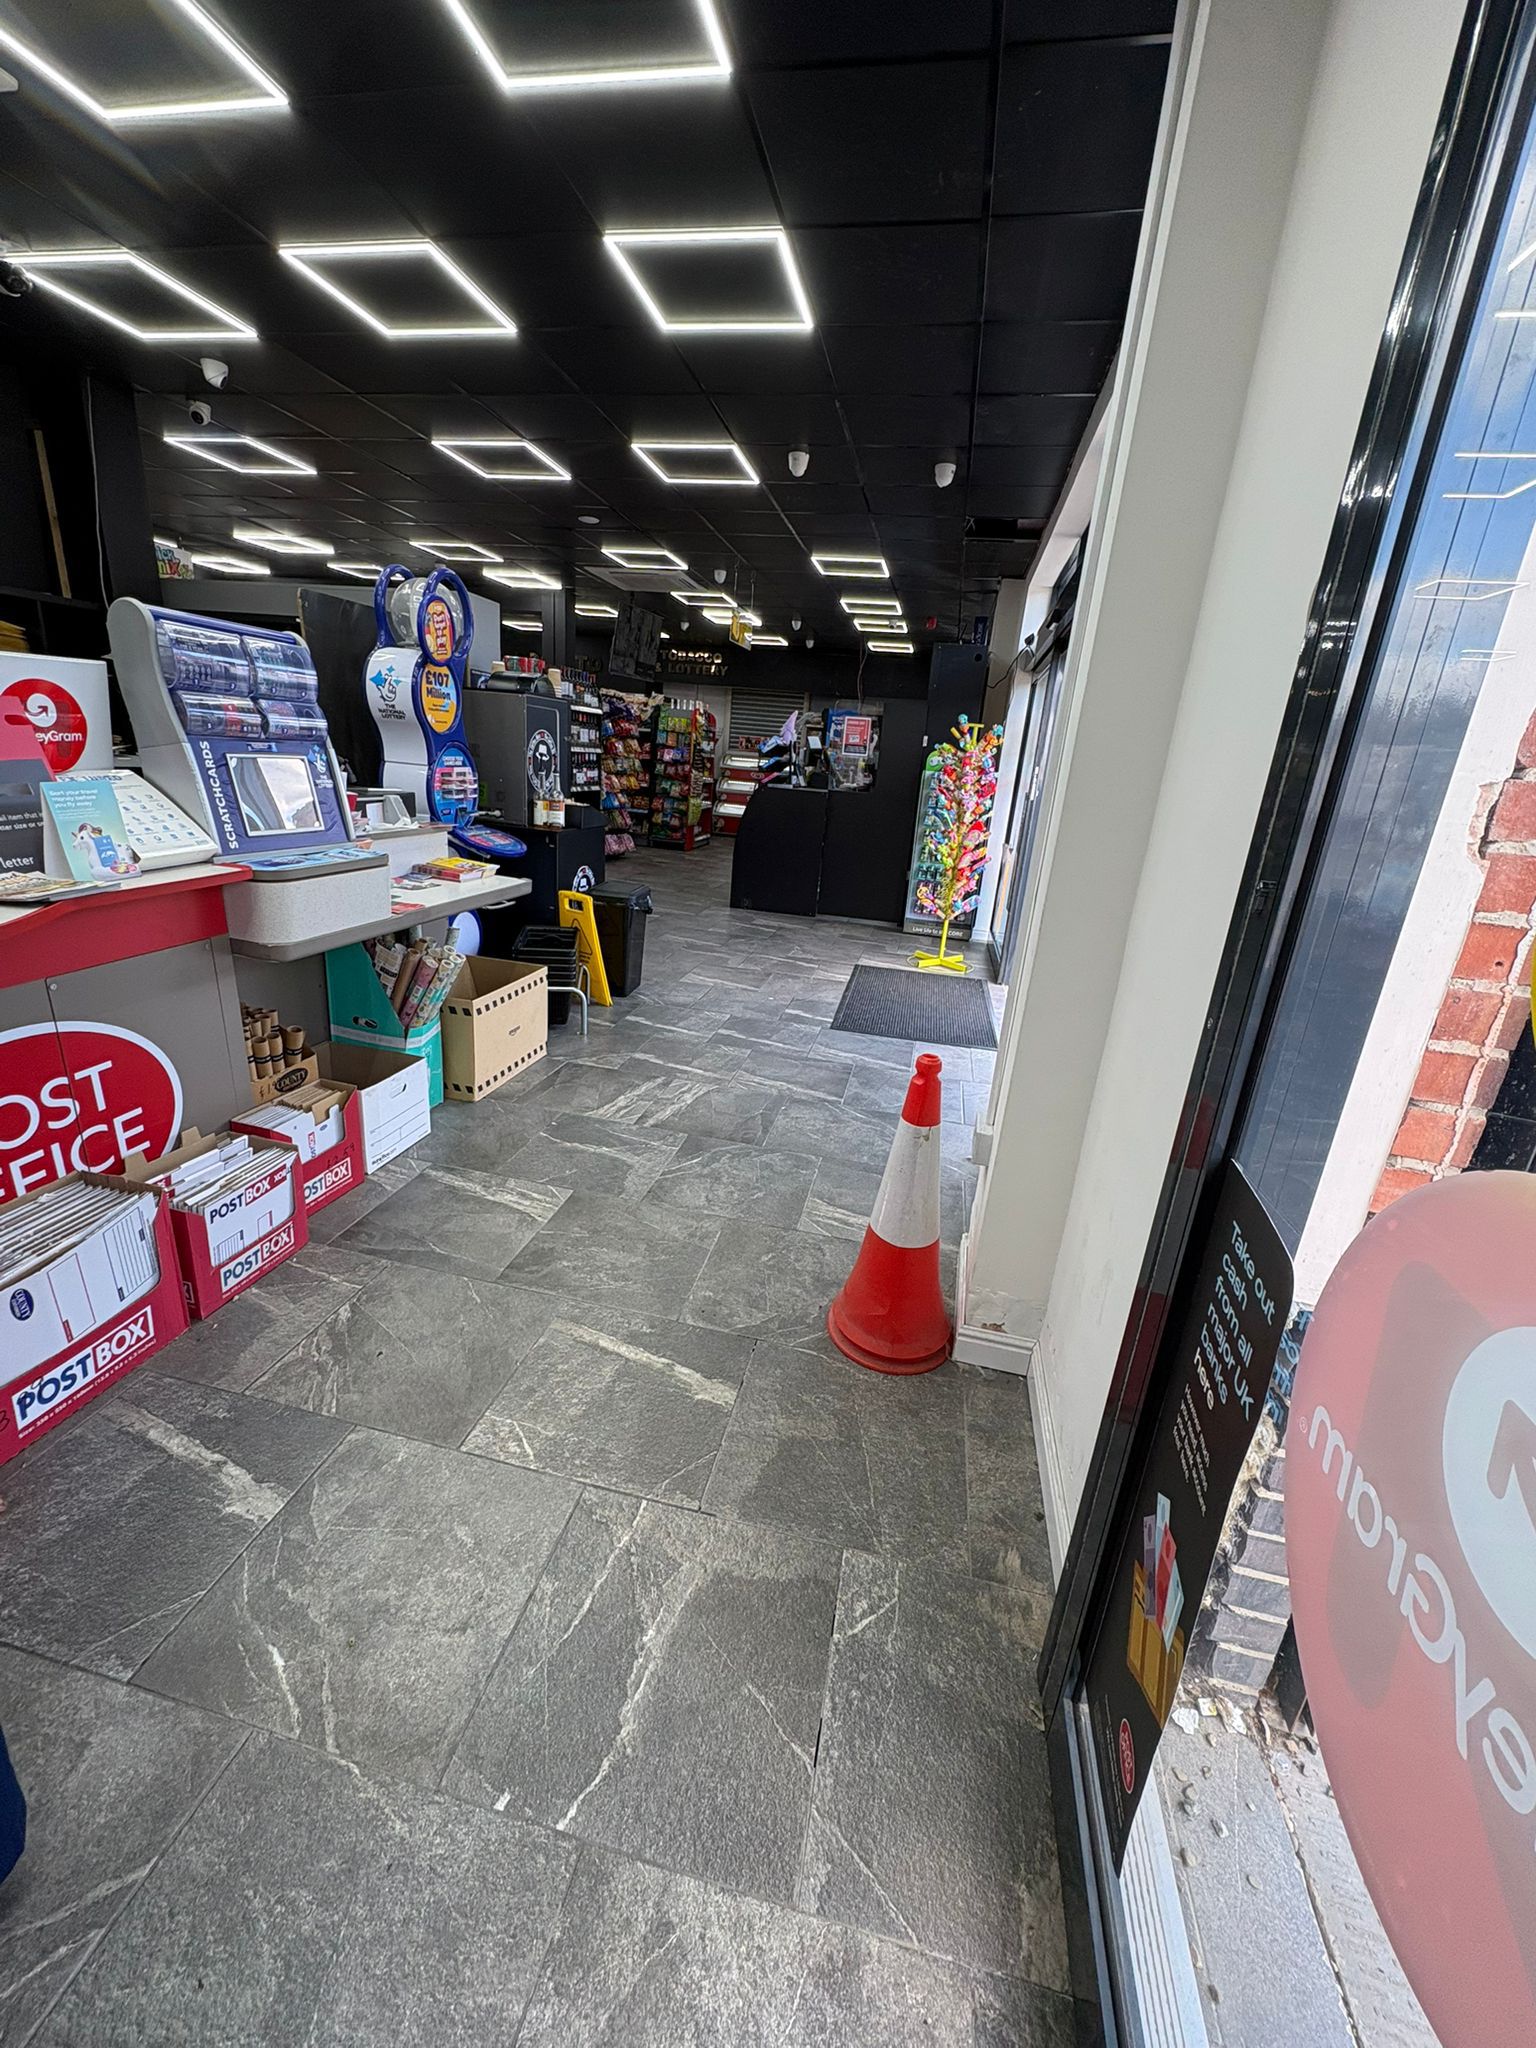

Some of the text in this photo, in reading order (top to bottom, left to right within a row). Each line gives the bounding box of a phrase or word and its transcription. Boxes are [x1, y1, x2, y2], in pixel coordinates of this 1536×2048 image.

[425, 670, 450, 688] £107
[660, 649, 722, 664] TOBACCO
[667, 663, 728, 676] LOTTERY
[378, 708, 406, 717] NATIONAL
[426, 686, 452, 701] Million
[200, 741, 239, 850] SCRATCHCARDS
[0, 855, 34, 869] letter
[278, 1070, 308, 1089] COUNTY
[0, 1107, 151, 1198] FICE
[1222, 1254, 1248, 1311] cash
[1232, 1220, 1275, 1326] Take out
[1215, 1275, 1253, 1369] from all
[1194, 1347, 1214, 1410] here
[1201, 1323, 1227, 1405] banks
[1208, 1302, 1254, 1422] major UK
[1181, 1399, 1190, 1420] you
[1185, 1383, 1210, 1468] However much
[1176, 1413, 1185, 1437] your
[1184, 1435, 1196, 1470] bank
